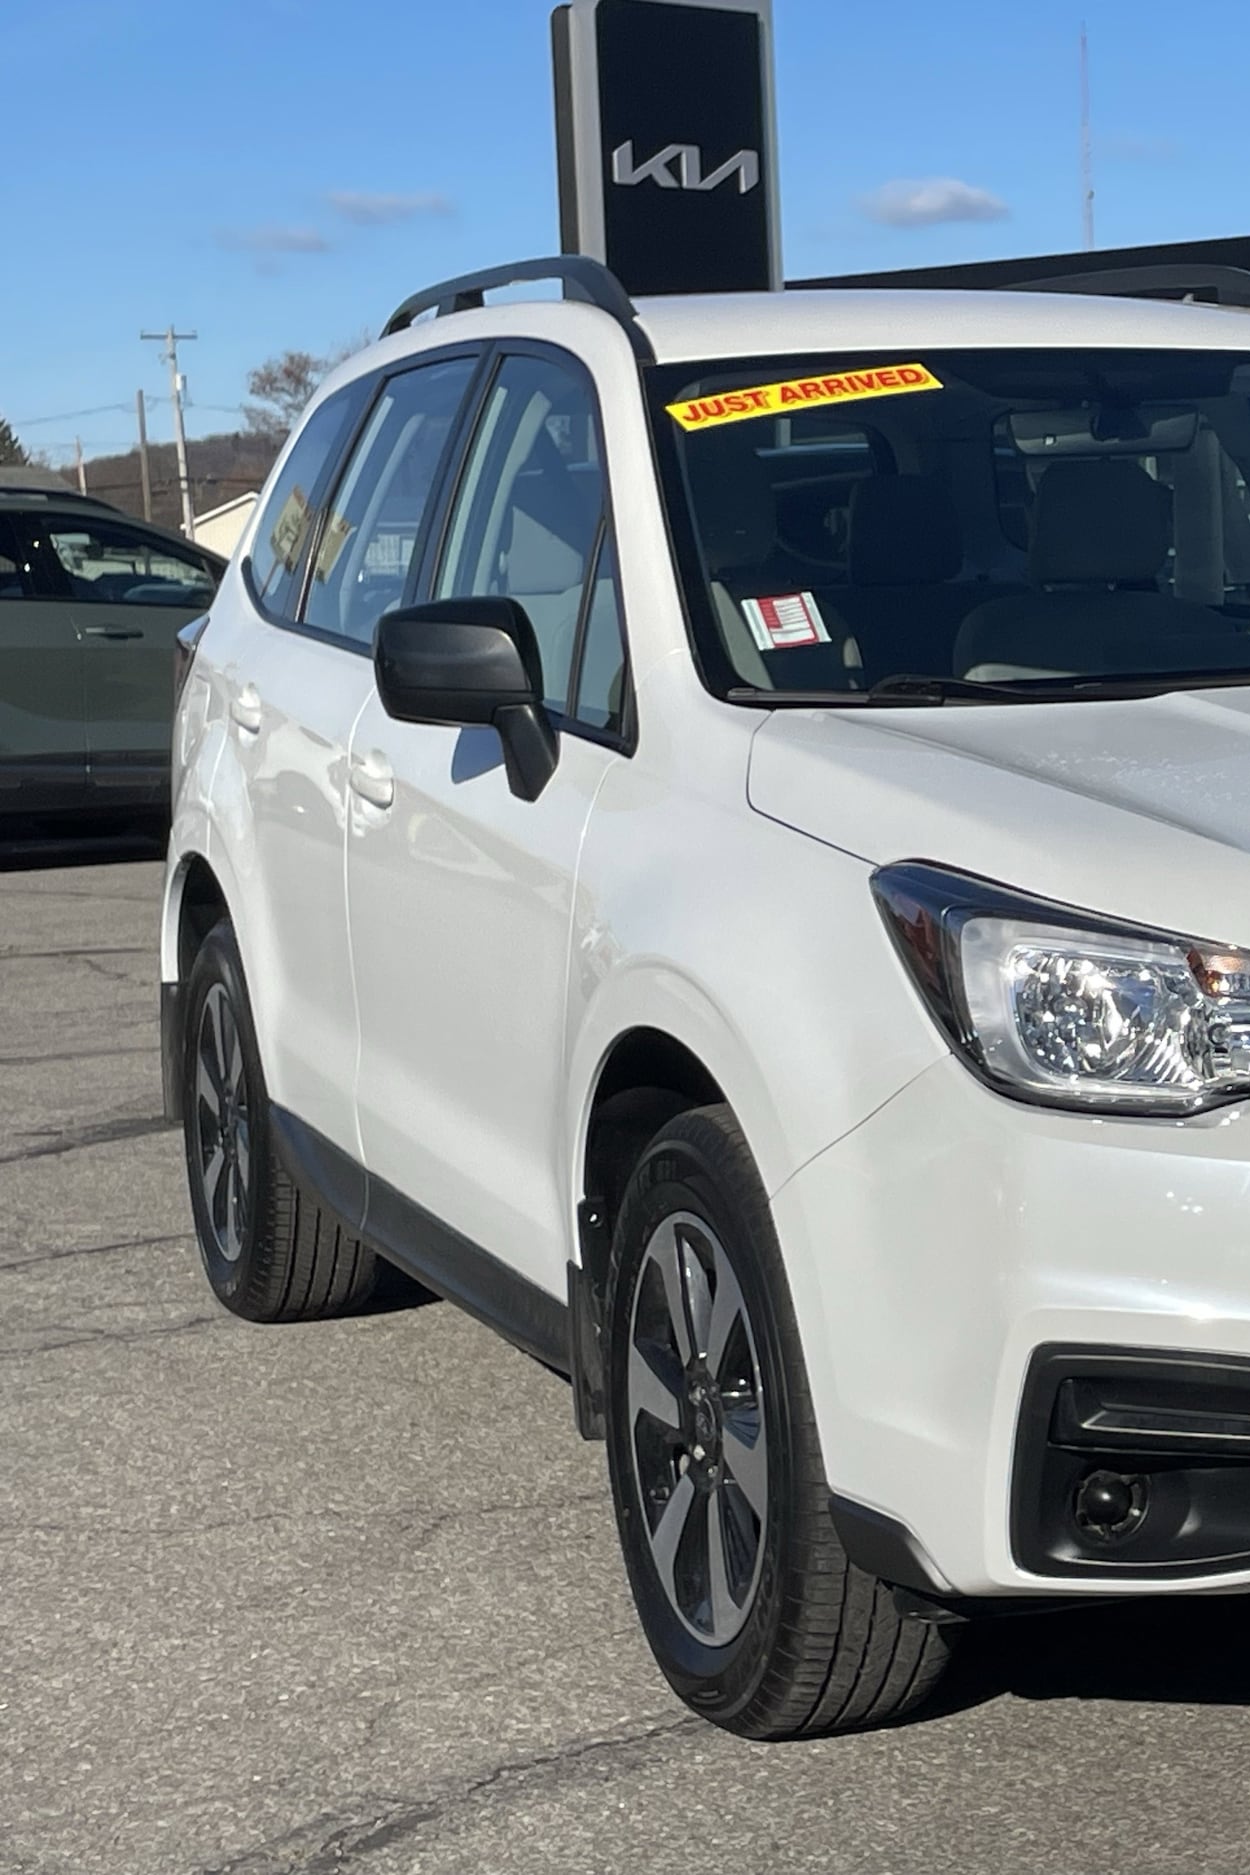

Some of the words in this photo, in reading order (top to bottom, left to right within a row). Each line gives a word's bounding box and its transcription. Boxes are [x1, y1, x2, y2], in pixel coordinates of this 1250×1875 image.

[612, 139, 759, 194] KIA
[683, 390, 767, 423] JUST
[780, 369, 926, 405] ARRIVED
